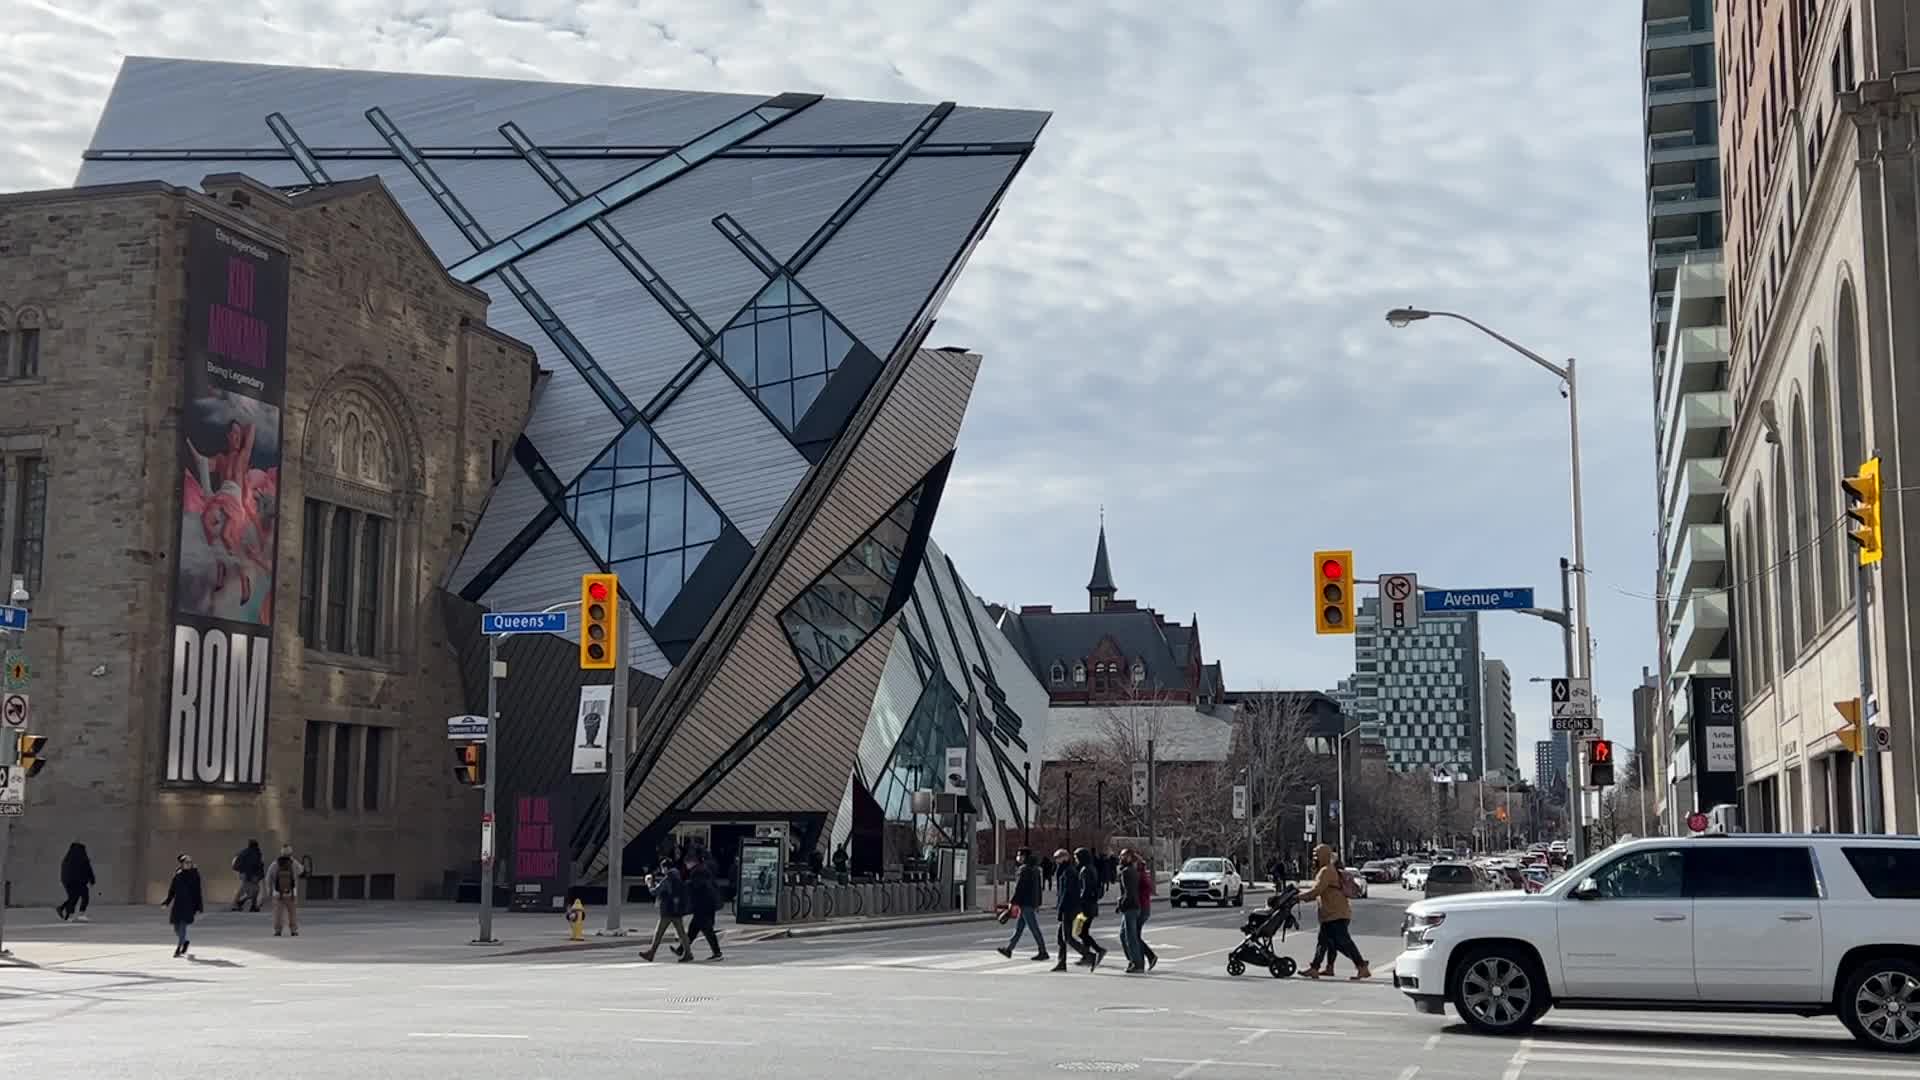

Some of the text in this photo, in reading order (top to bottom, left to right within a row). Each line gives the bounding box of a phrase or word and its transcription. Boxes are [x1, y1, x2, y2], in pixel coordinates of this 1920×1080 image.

[1443, 592, 1500, 606] Avenue
[494, 615, 544, 629] Queens
[167, 624, 270, 784] ROM
[1556, 719, 1590, 729] BEGINS
[0, 805, 23, 814] EGINS
